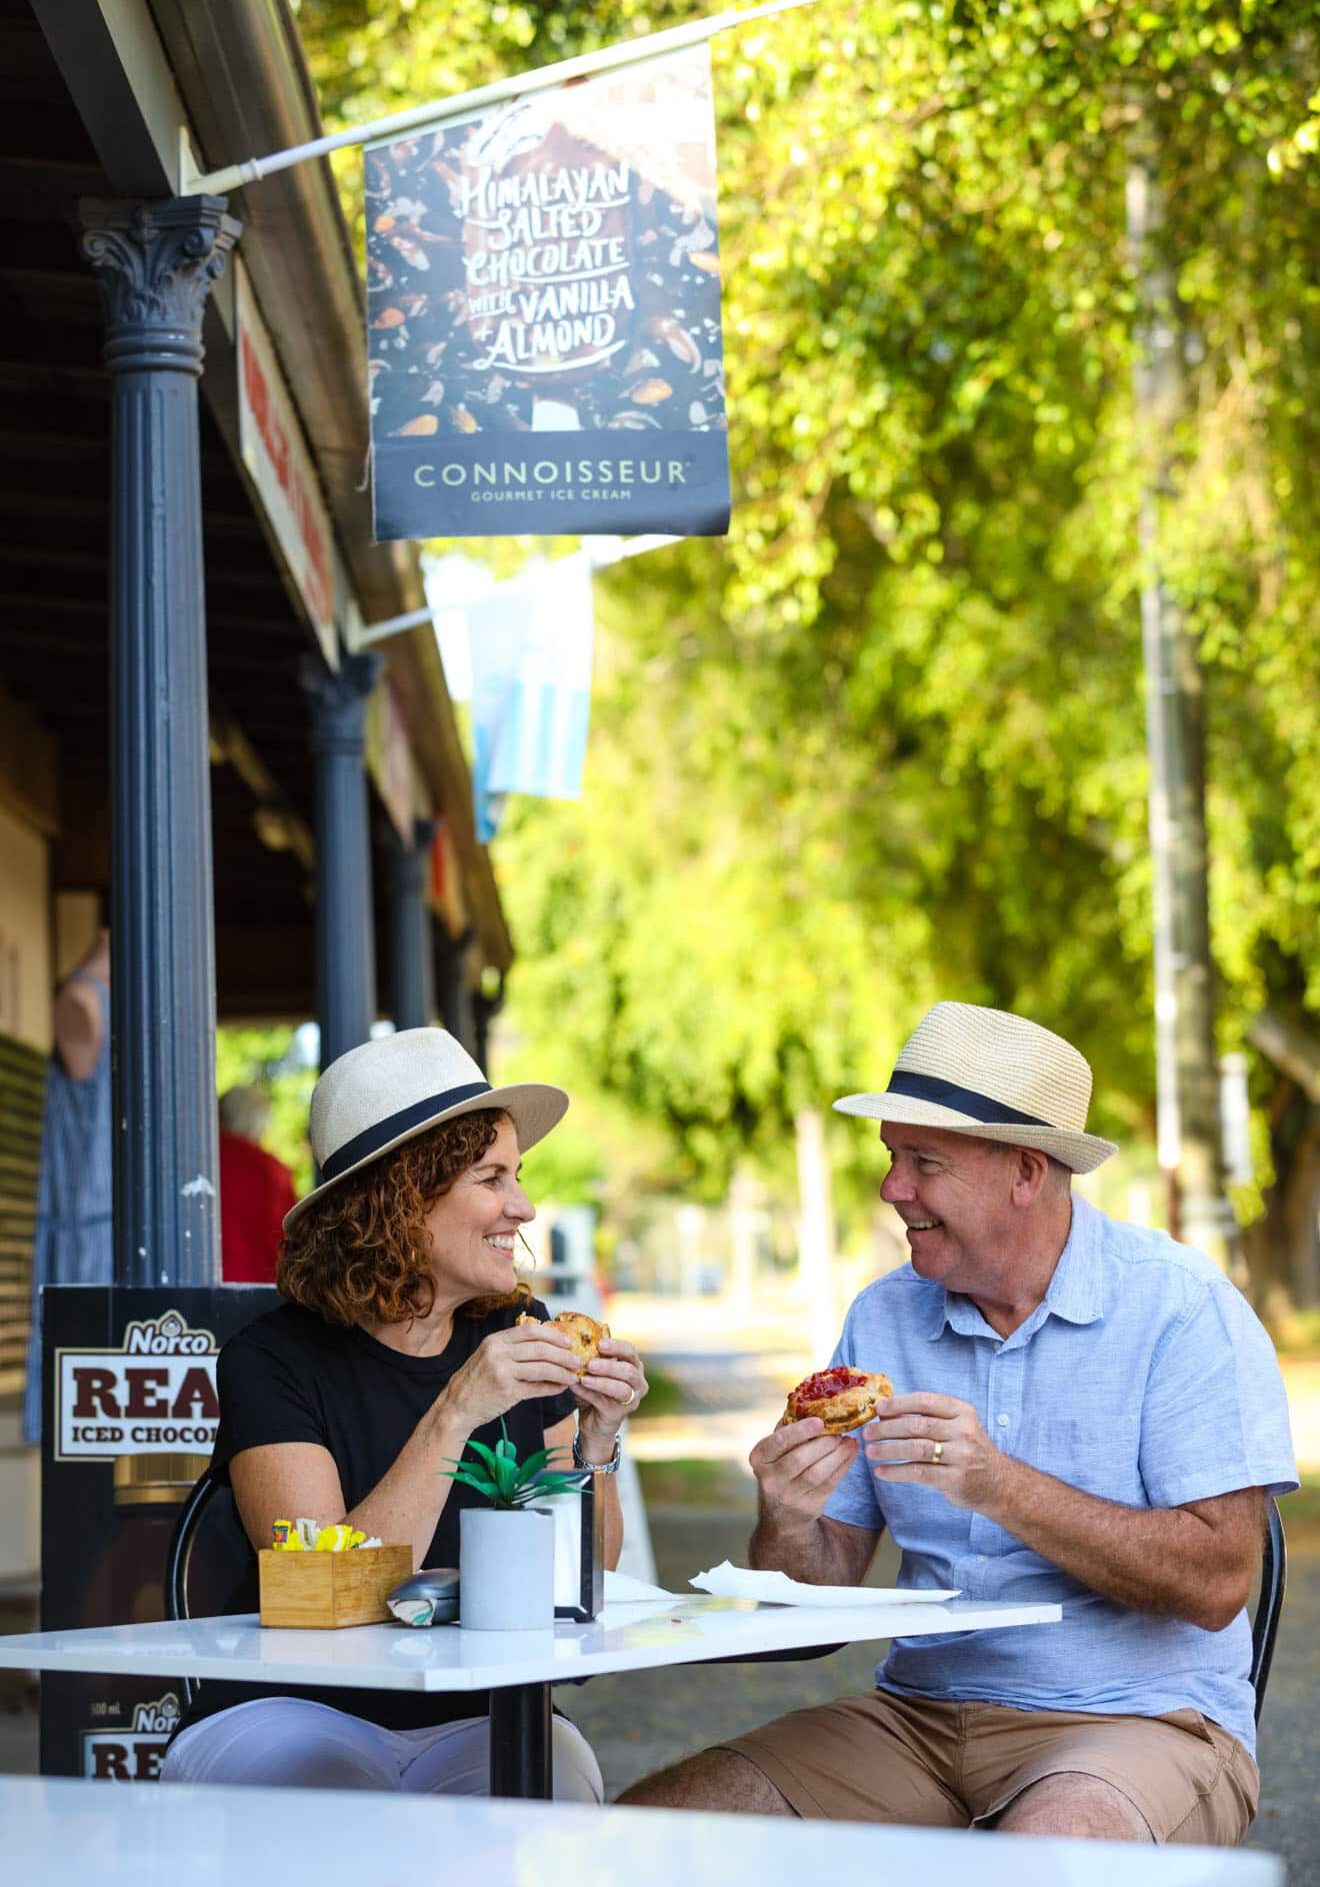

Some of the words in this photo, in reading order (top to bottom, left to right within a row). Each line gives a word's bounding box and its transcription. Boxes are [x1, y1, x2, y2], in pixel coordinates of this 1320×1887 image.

[461, 160, 632, 218] HIMALAYAN
[487, 205, 603, 251] SALTED
[462, 237, 626, 287] CHOCOLATE
[468, 290, 517, 319] WITH
[519, 275, 636, 324] VANILLA
[474, 313, 617, 367] ALMOND
[414, 460, 686, 487] CONNOISSEUR
[470, 490, 544, 501] GOURMET
[550, 489, 575, 500] ICE
[581, 489, 631, 500] CREAM
[129, 1325, 208, 1354] Norco
[72, 1367, 220, 1419] REA
[72, 1426, 124, 1442] ICED
[137, 1709, 181, 1732] Nor
